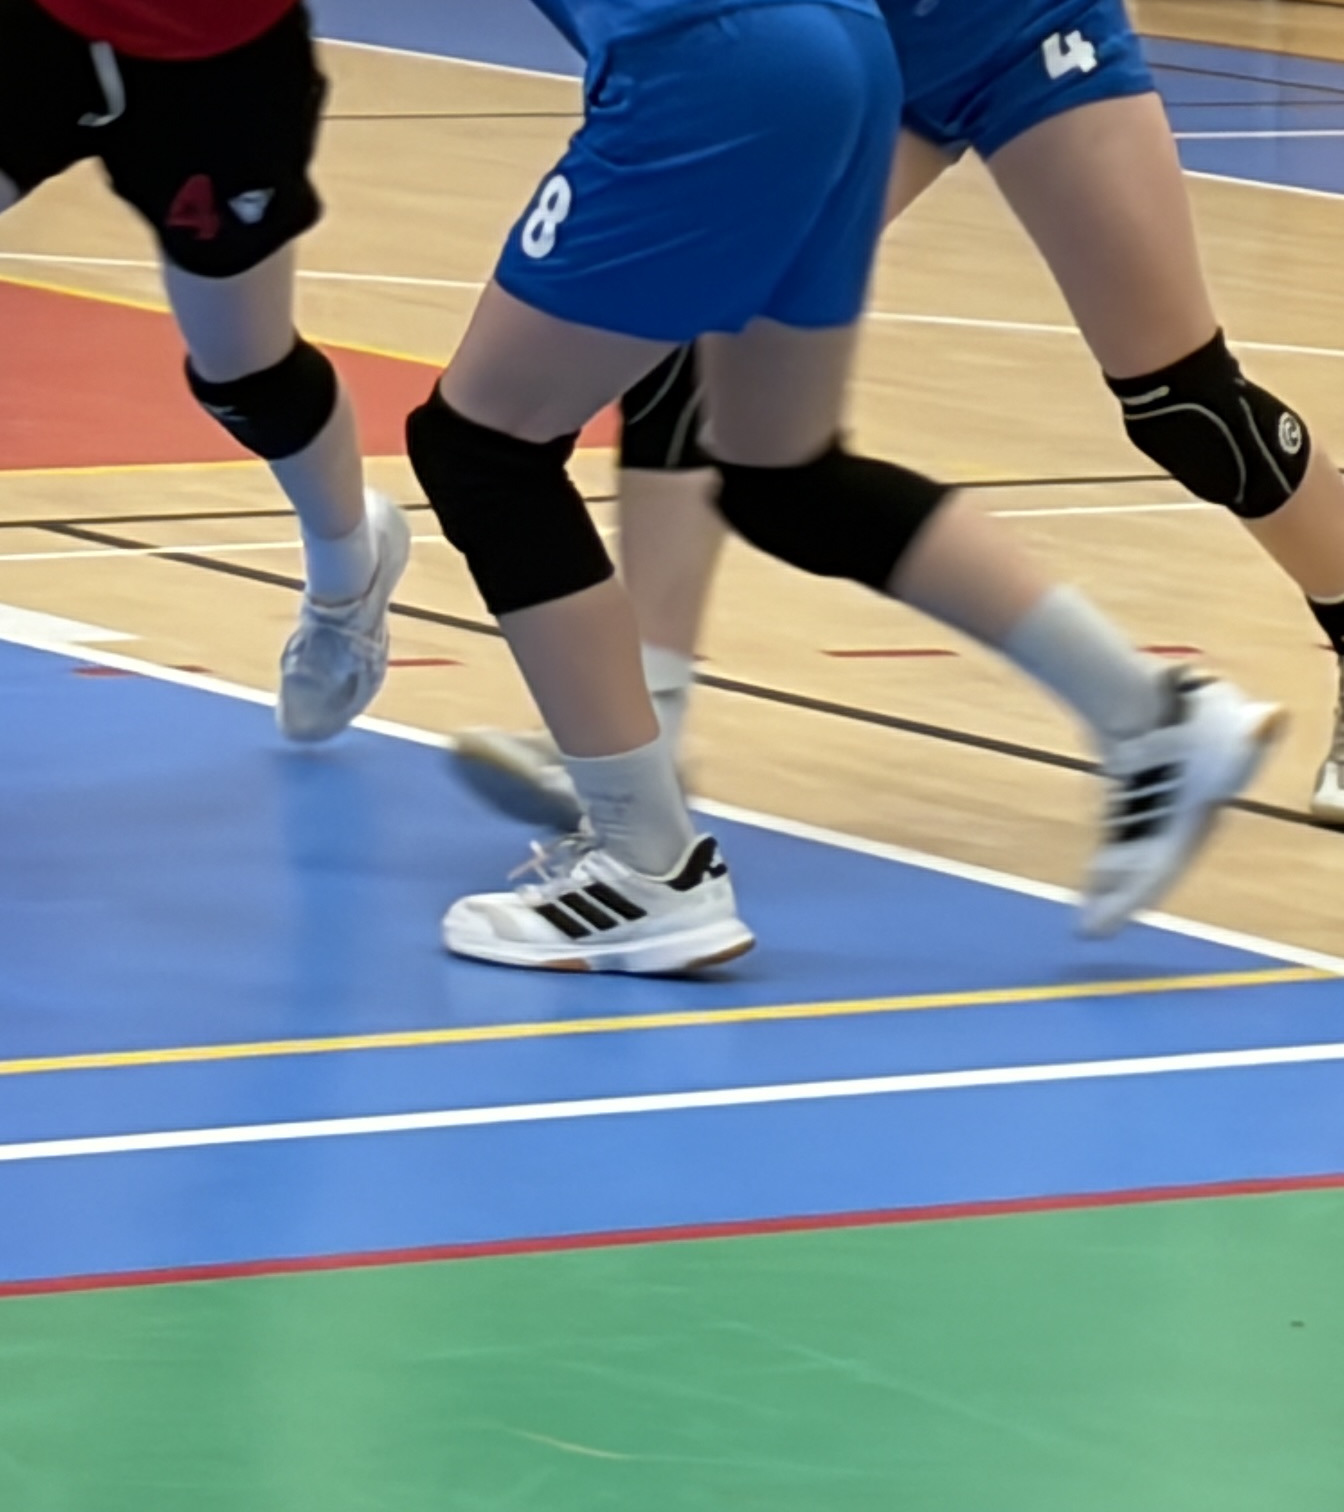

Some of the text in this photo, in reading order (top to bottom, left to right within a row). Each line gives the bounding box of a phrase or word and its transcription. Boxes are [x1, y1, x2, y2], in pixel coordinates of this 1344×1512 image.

[1041, 29, 1099, 81] 4
[166, 172, 222, 241] 4
[520, 173, 572, 259] 8
